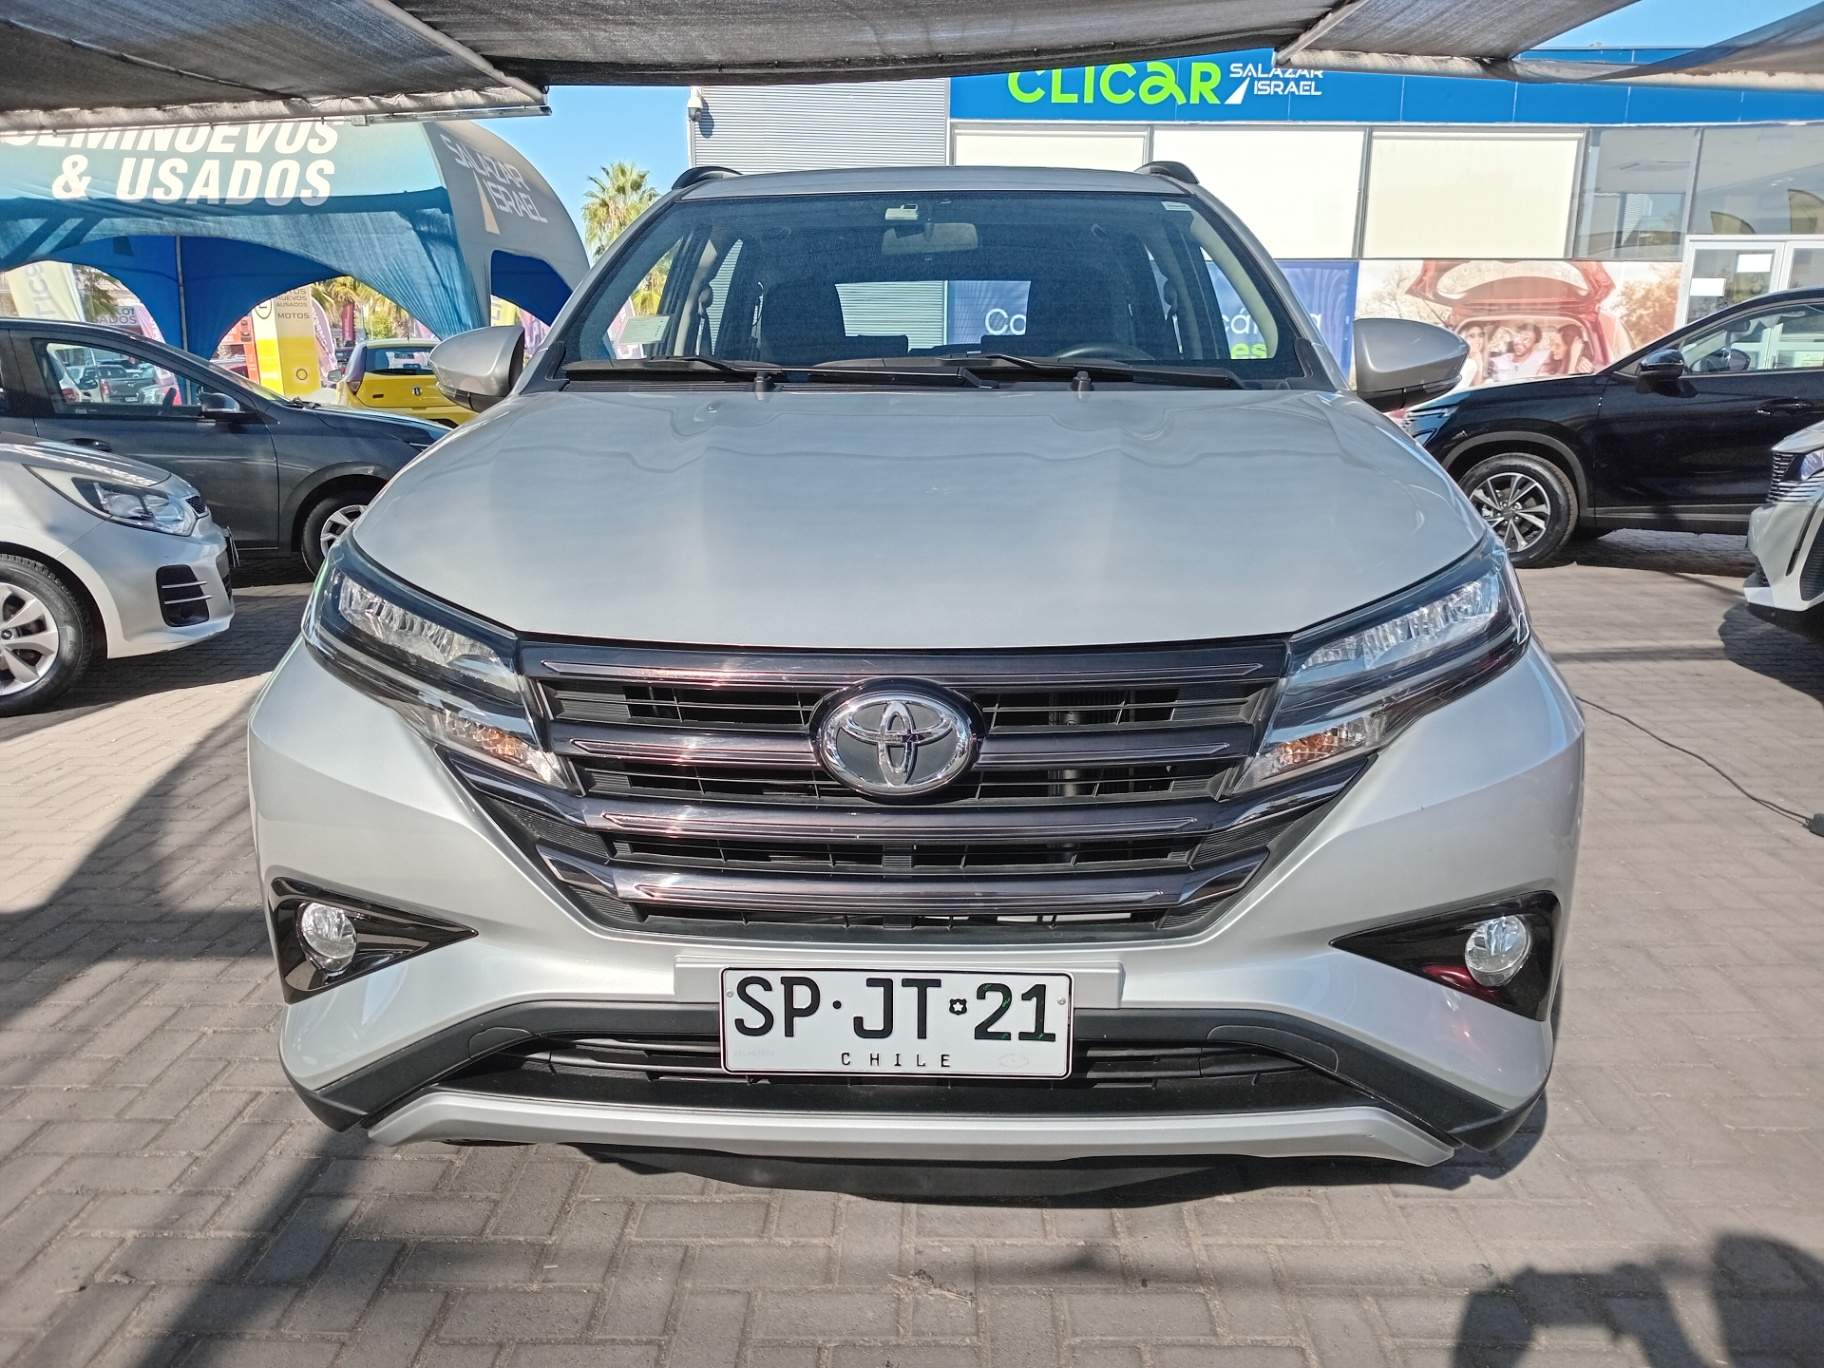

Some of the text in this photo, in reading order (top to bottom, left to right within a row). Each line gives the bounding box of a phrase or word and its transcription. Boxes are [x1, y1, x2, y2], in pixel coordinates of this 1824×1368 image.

[1254, 80, 1322, 96] ISRAEL
[52, 154, 335, 206] & USADOS
[482, 179, 548, 224] ISRAEL
[841, 1052, 951, 1068] CHILE
